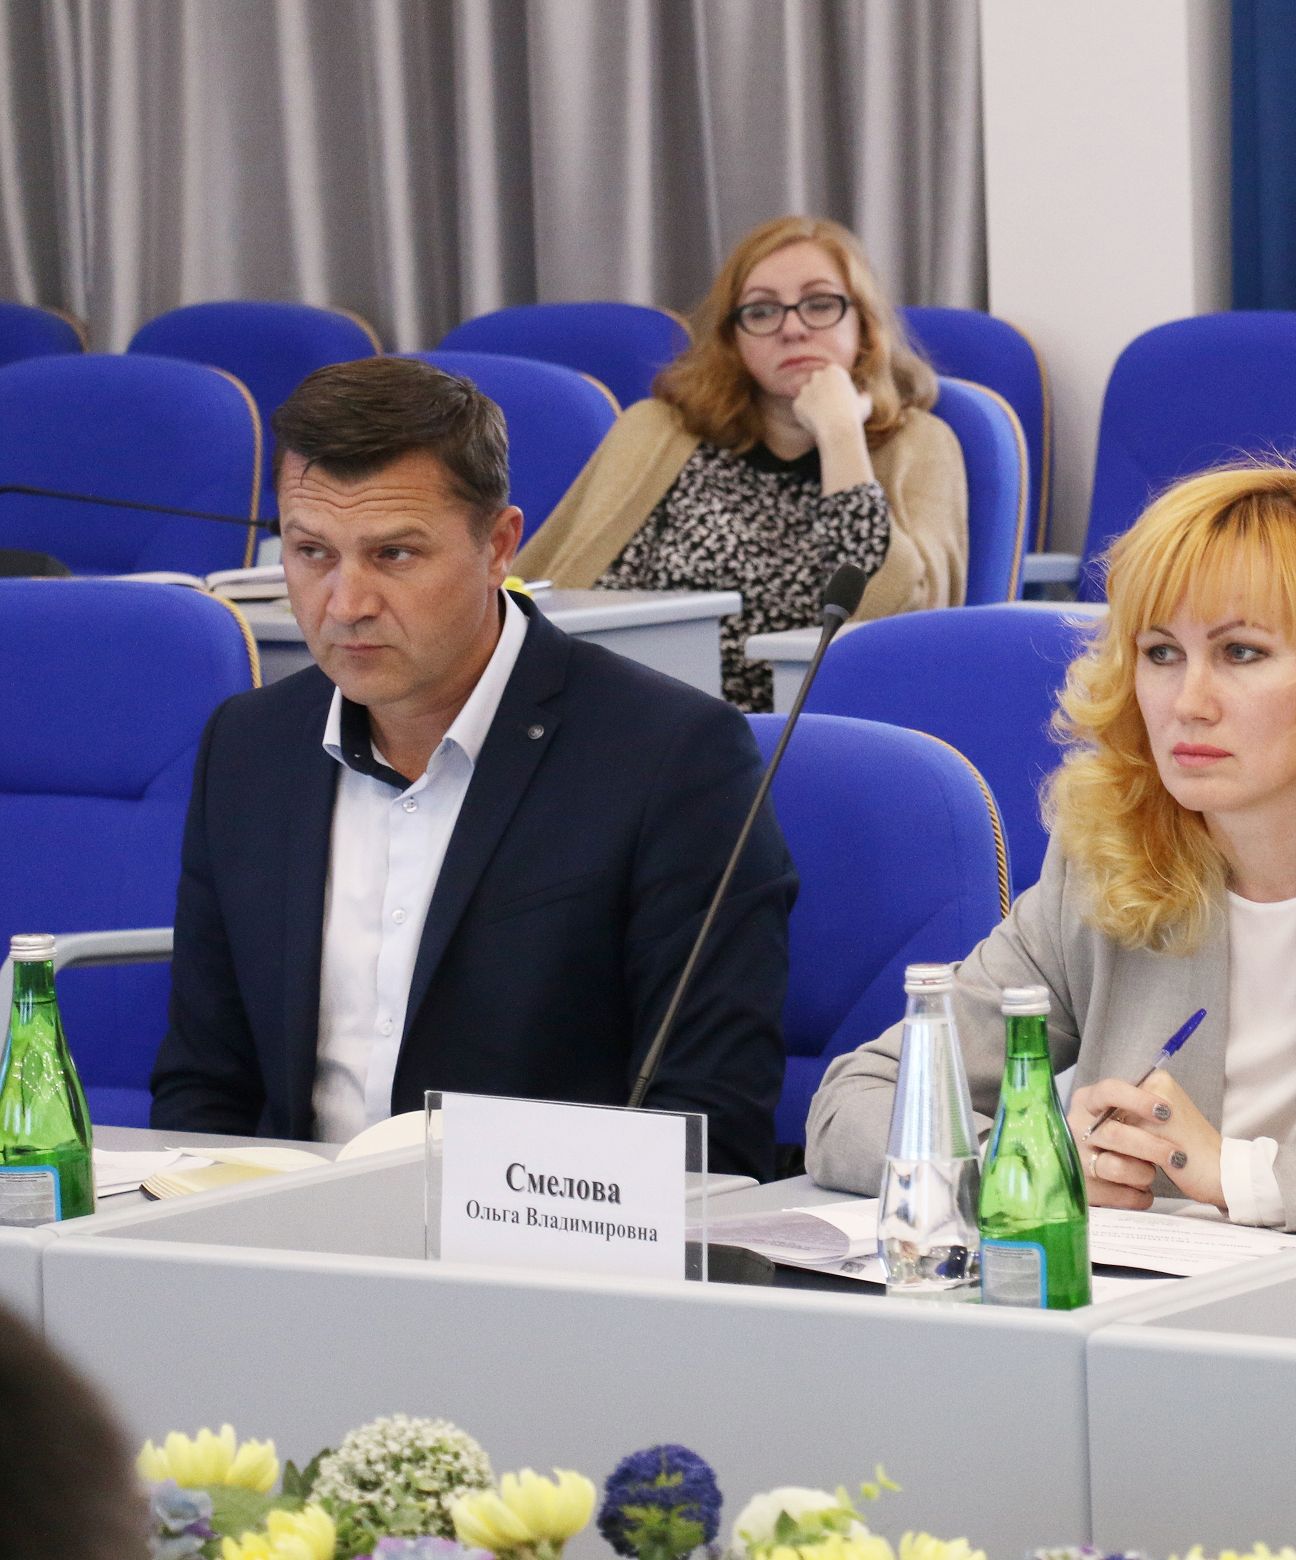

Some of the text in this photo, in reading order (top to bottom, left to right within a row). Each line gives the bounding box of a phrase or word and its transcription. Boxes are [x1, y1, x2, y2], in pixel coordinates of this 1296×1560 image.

[505, 1162, 621, 1205] Смелова
[466, 1199, 658, 1242] Ольга Владимировна
